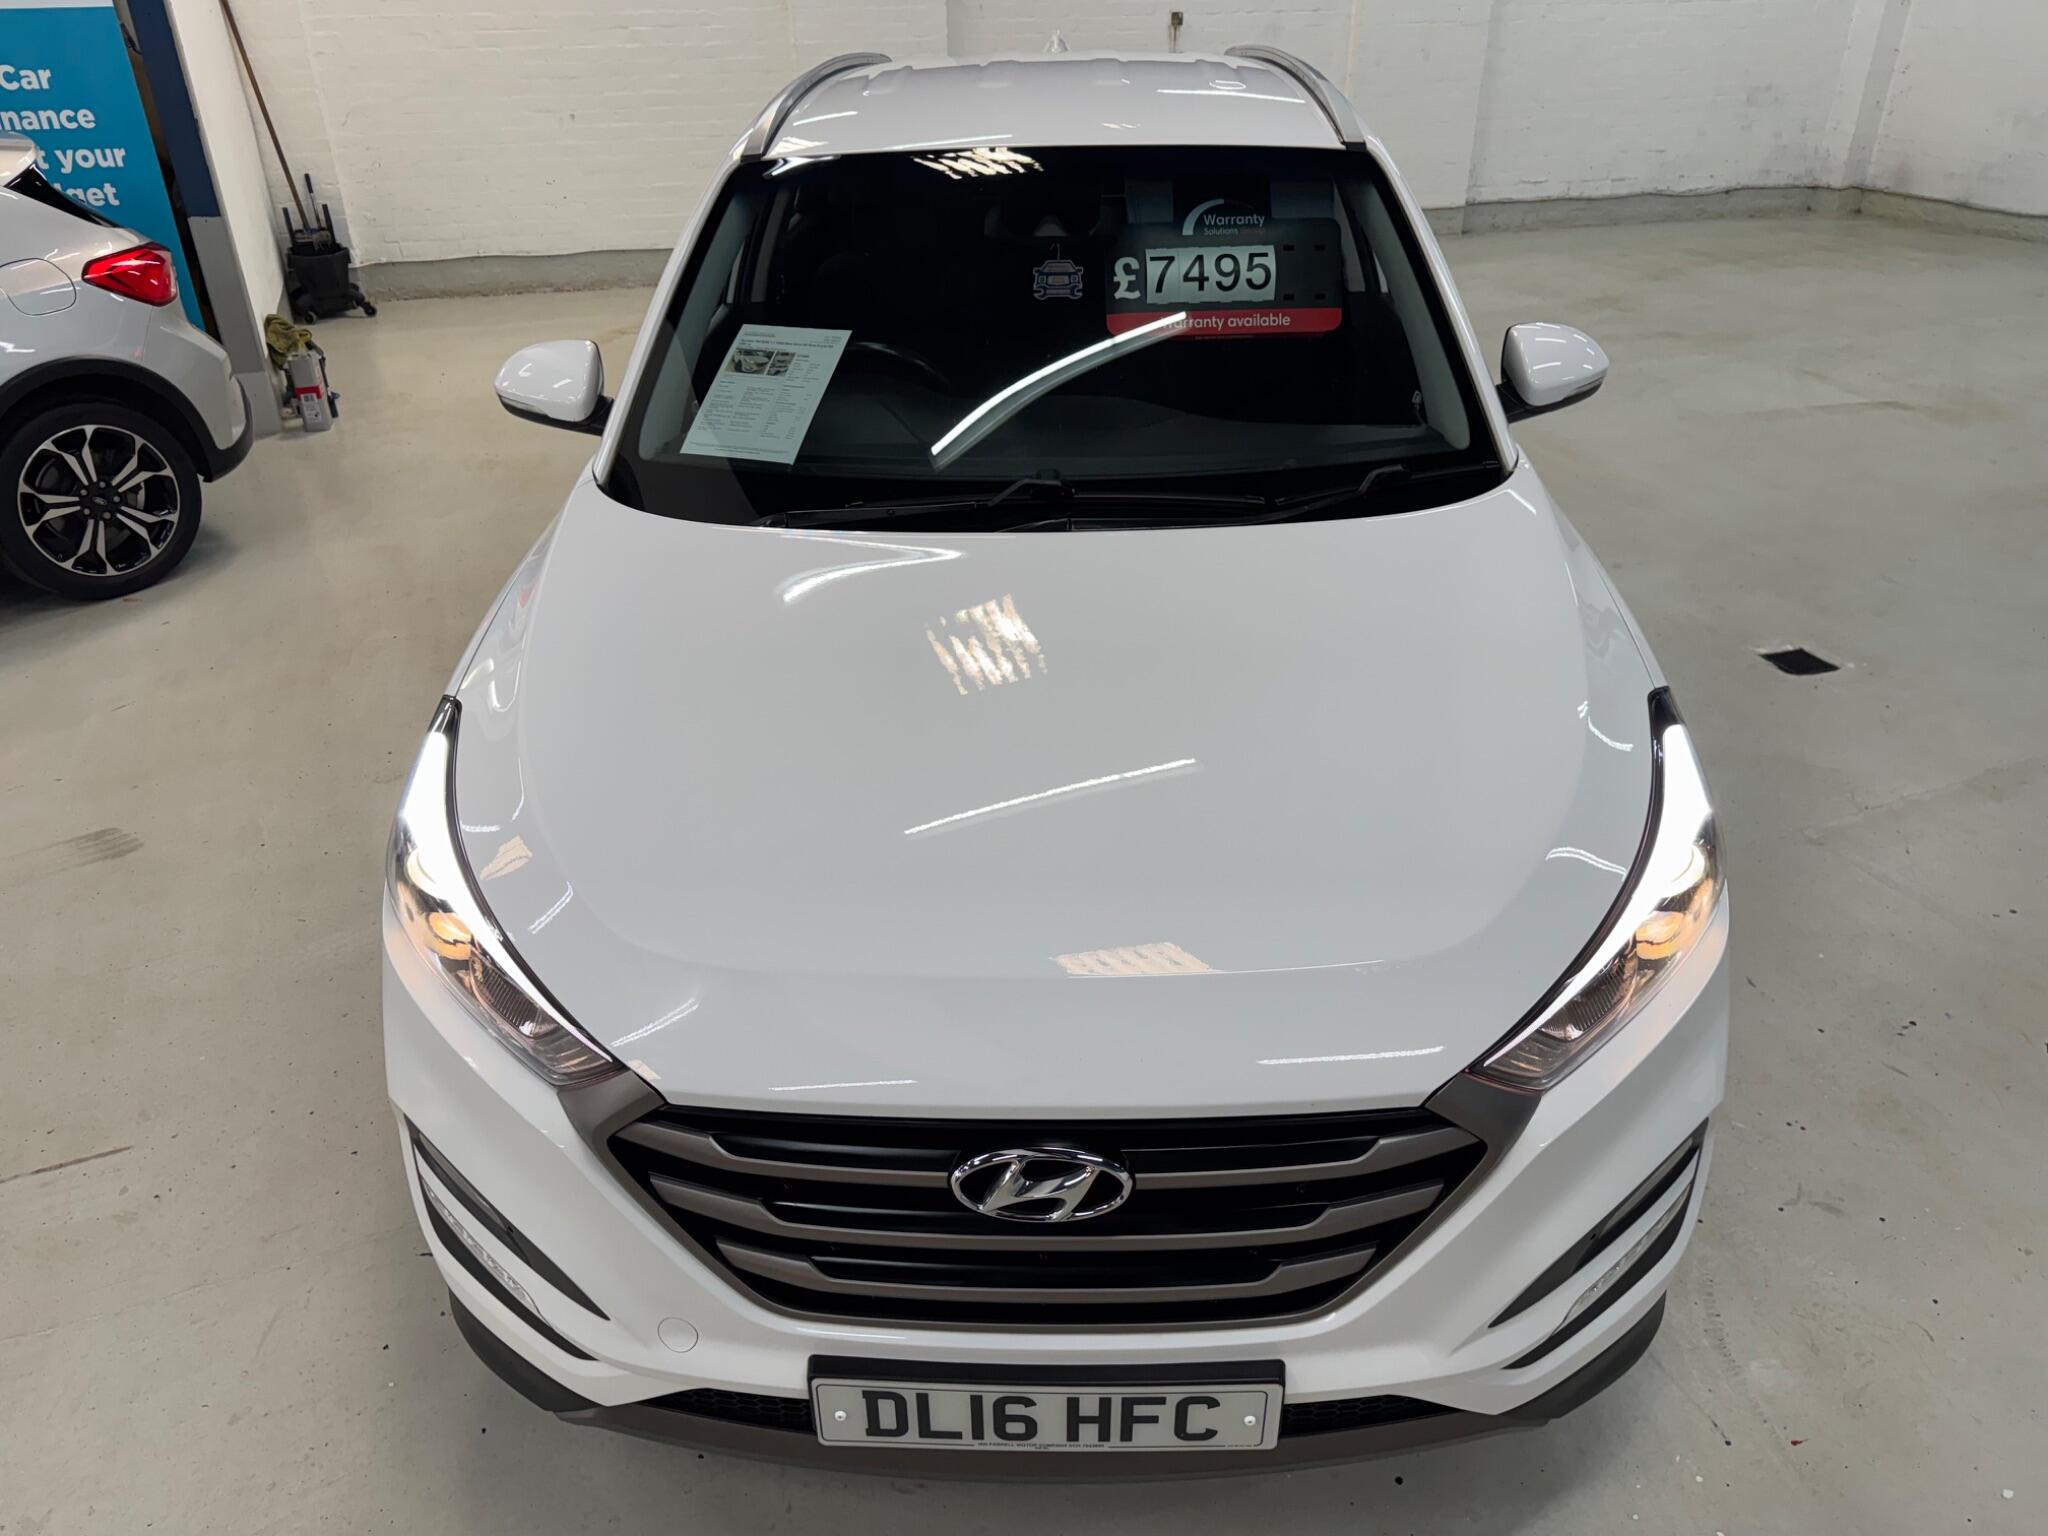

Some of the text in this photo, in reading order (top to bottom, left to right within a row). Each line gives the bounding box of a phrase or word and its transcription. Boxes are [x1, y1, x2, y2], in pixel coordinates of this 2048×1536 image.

[0, 64, 51, 91] Car
[0, 108, 96, 130] nance
[54, 148, 126, 174] your
[1203, 213, 1265, 228] Warranty
[1227, 313, 1291, 327] available
[861, 1390, 1221, 1442] DL16 HFC
